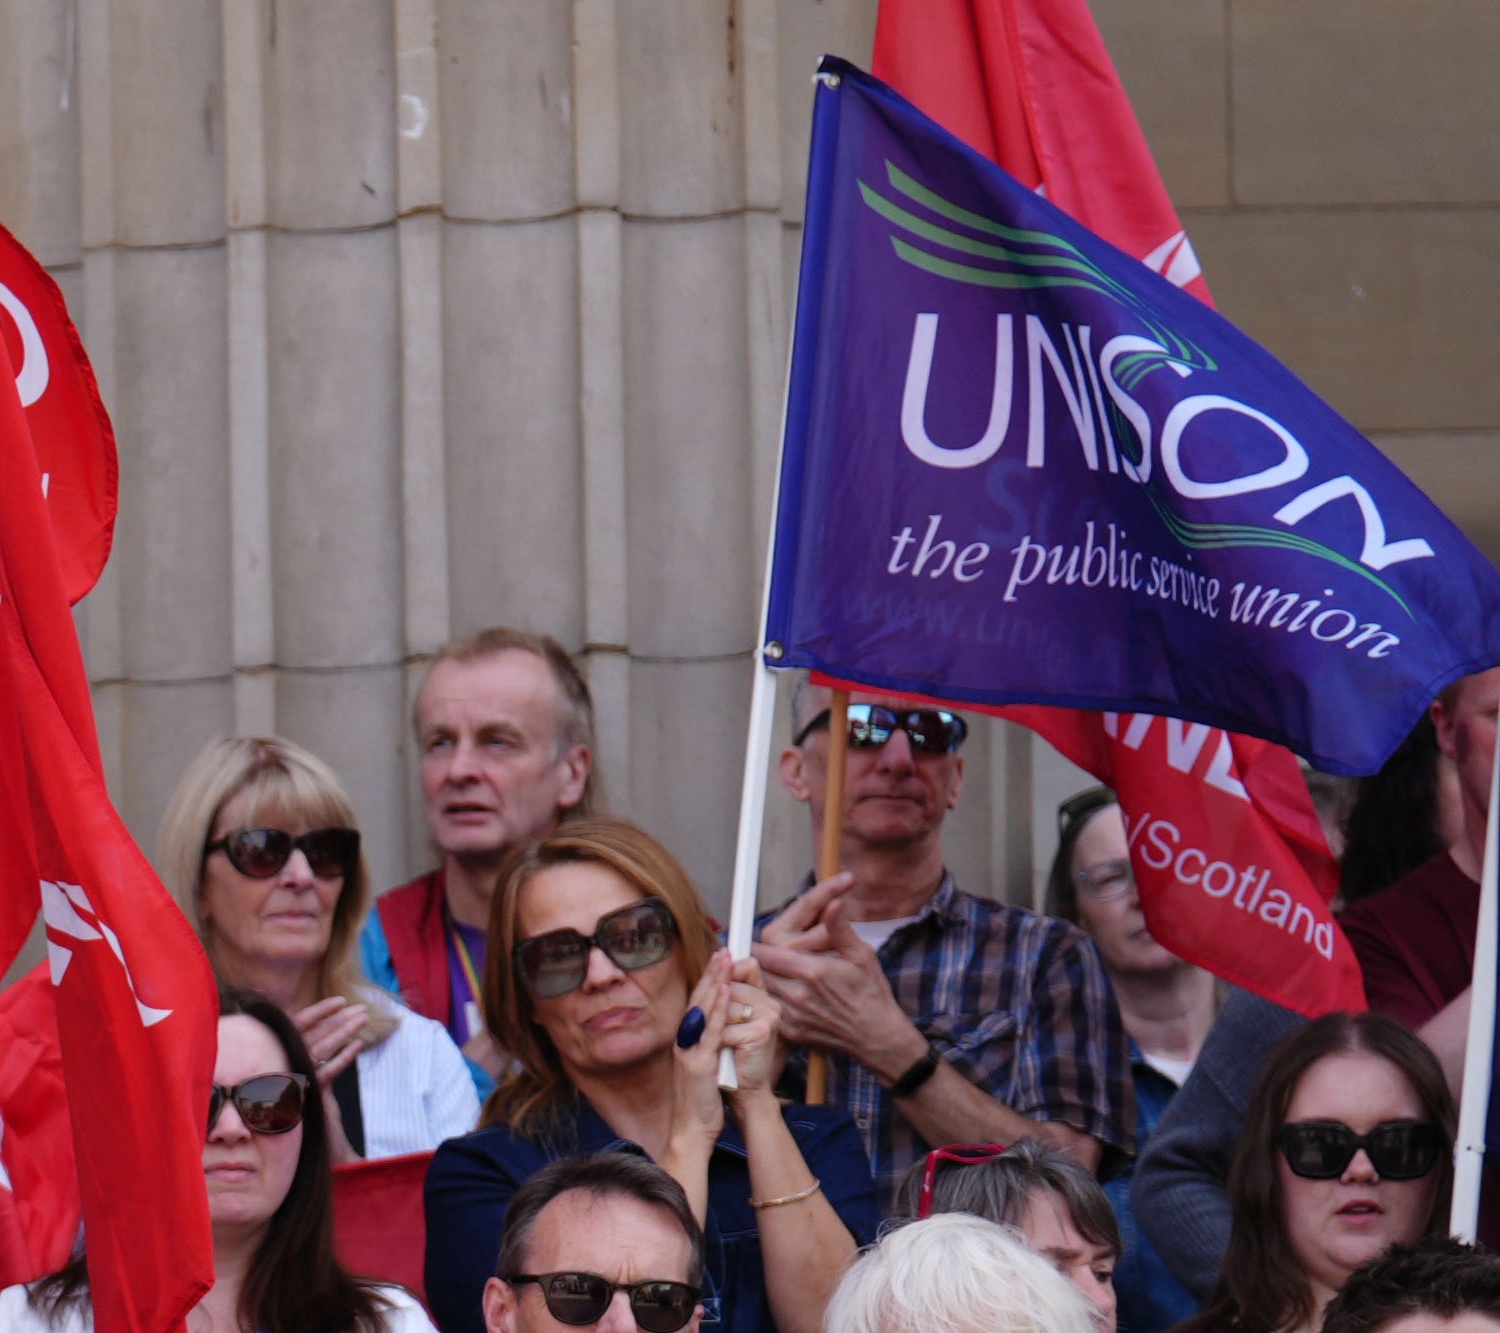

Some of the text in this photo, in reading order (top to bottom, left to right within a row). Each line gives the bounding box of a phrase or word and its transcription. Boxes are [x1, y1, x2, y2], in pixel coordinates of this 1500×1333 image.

[900, 313, 1436, 571] UNISON
[887, 515, 1400, 661] the public service union
